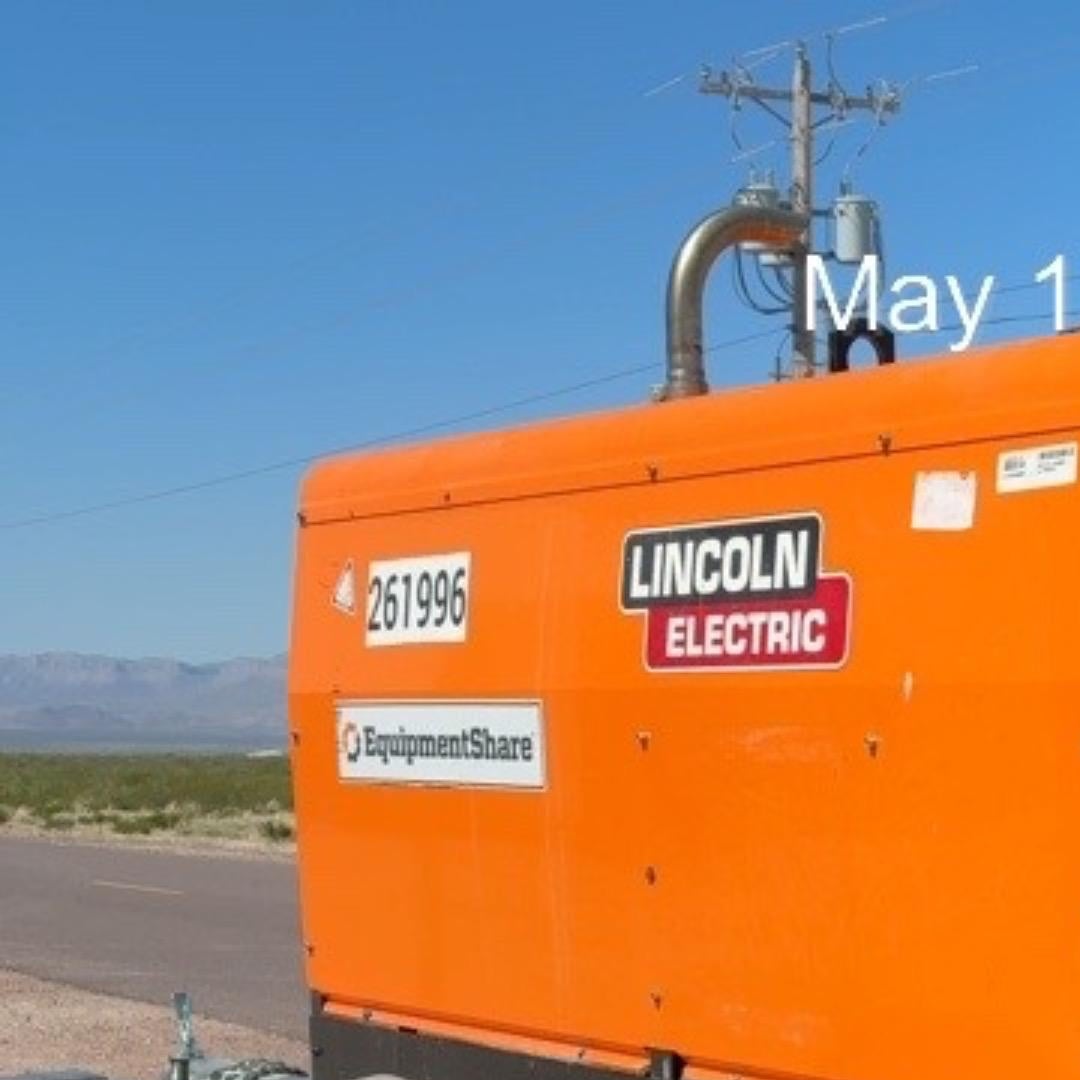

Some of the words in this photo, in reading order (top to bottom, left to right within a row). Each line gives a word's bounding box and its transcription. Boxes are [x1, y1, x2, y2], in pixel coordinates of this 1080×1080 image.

[629, 530, 808, 599] LINCOLN
[367, 566, 466, 632] 261996
[665, 608, 827, 658] ELECTRIC
[362, 725, 534, 766] EquipmentShare
